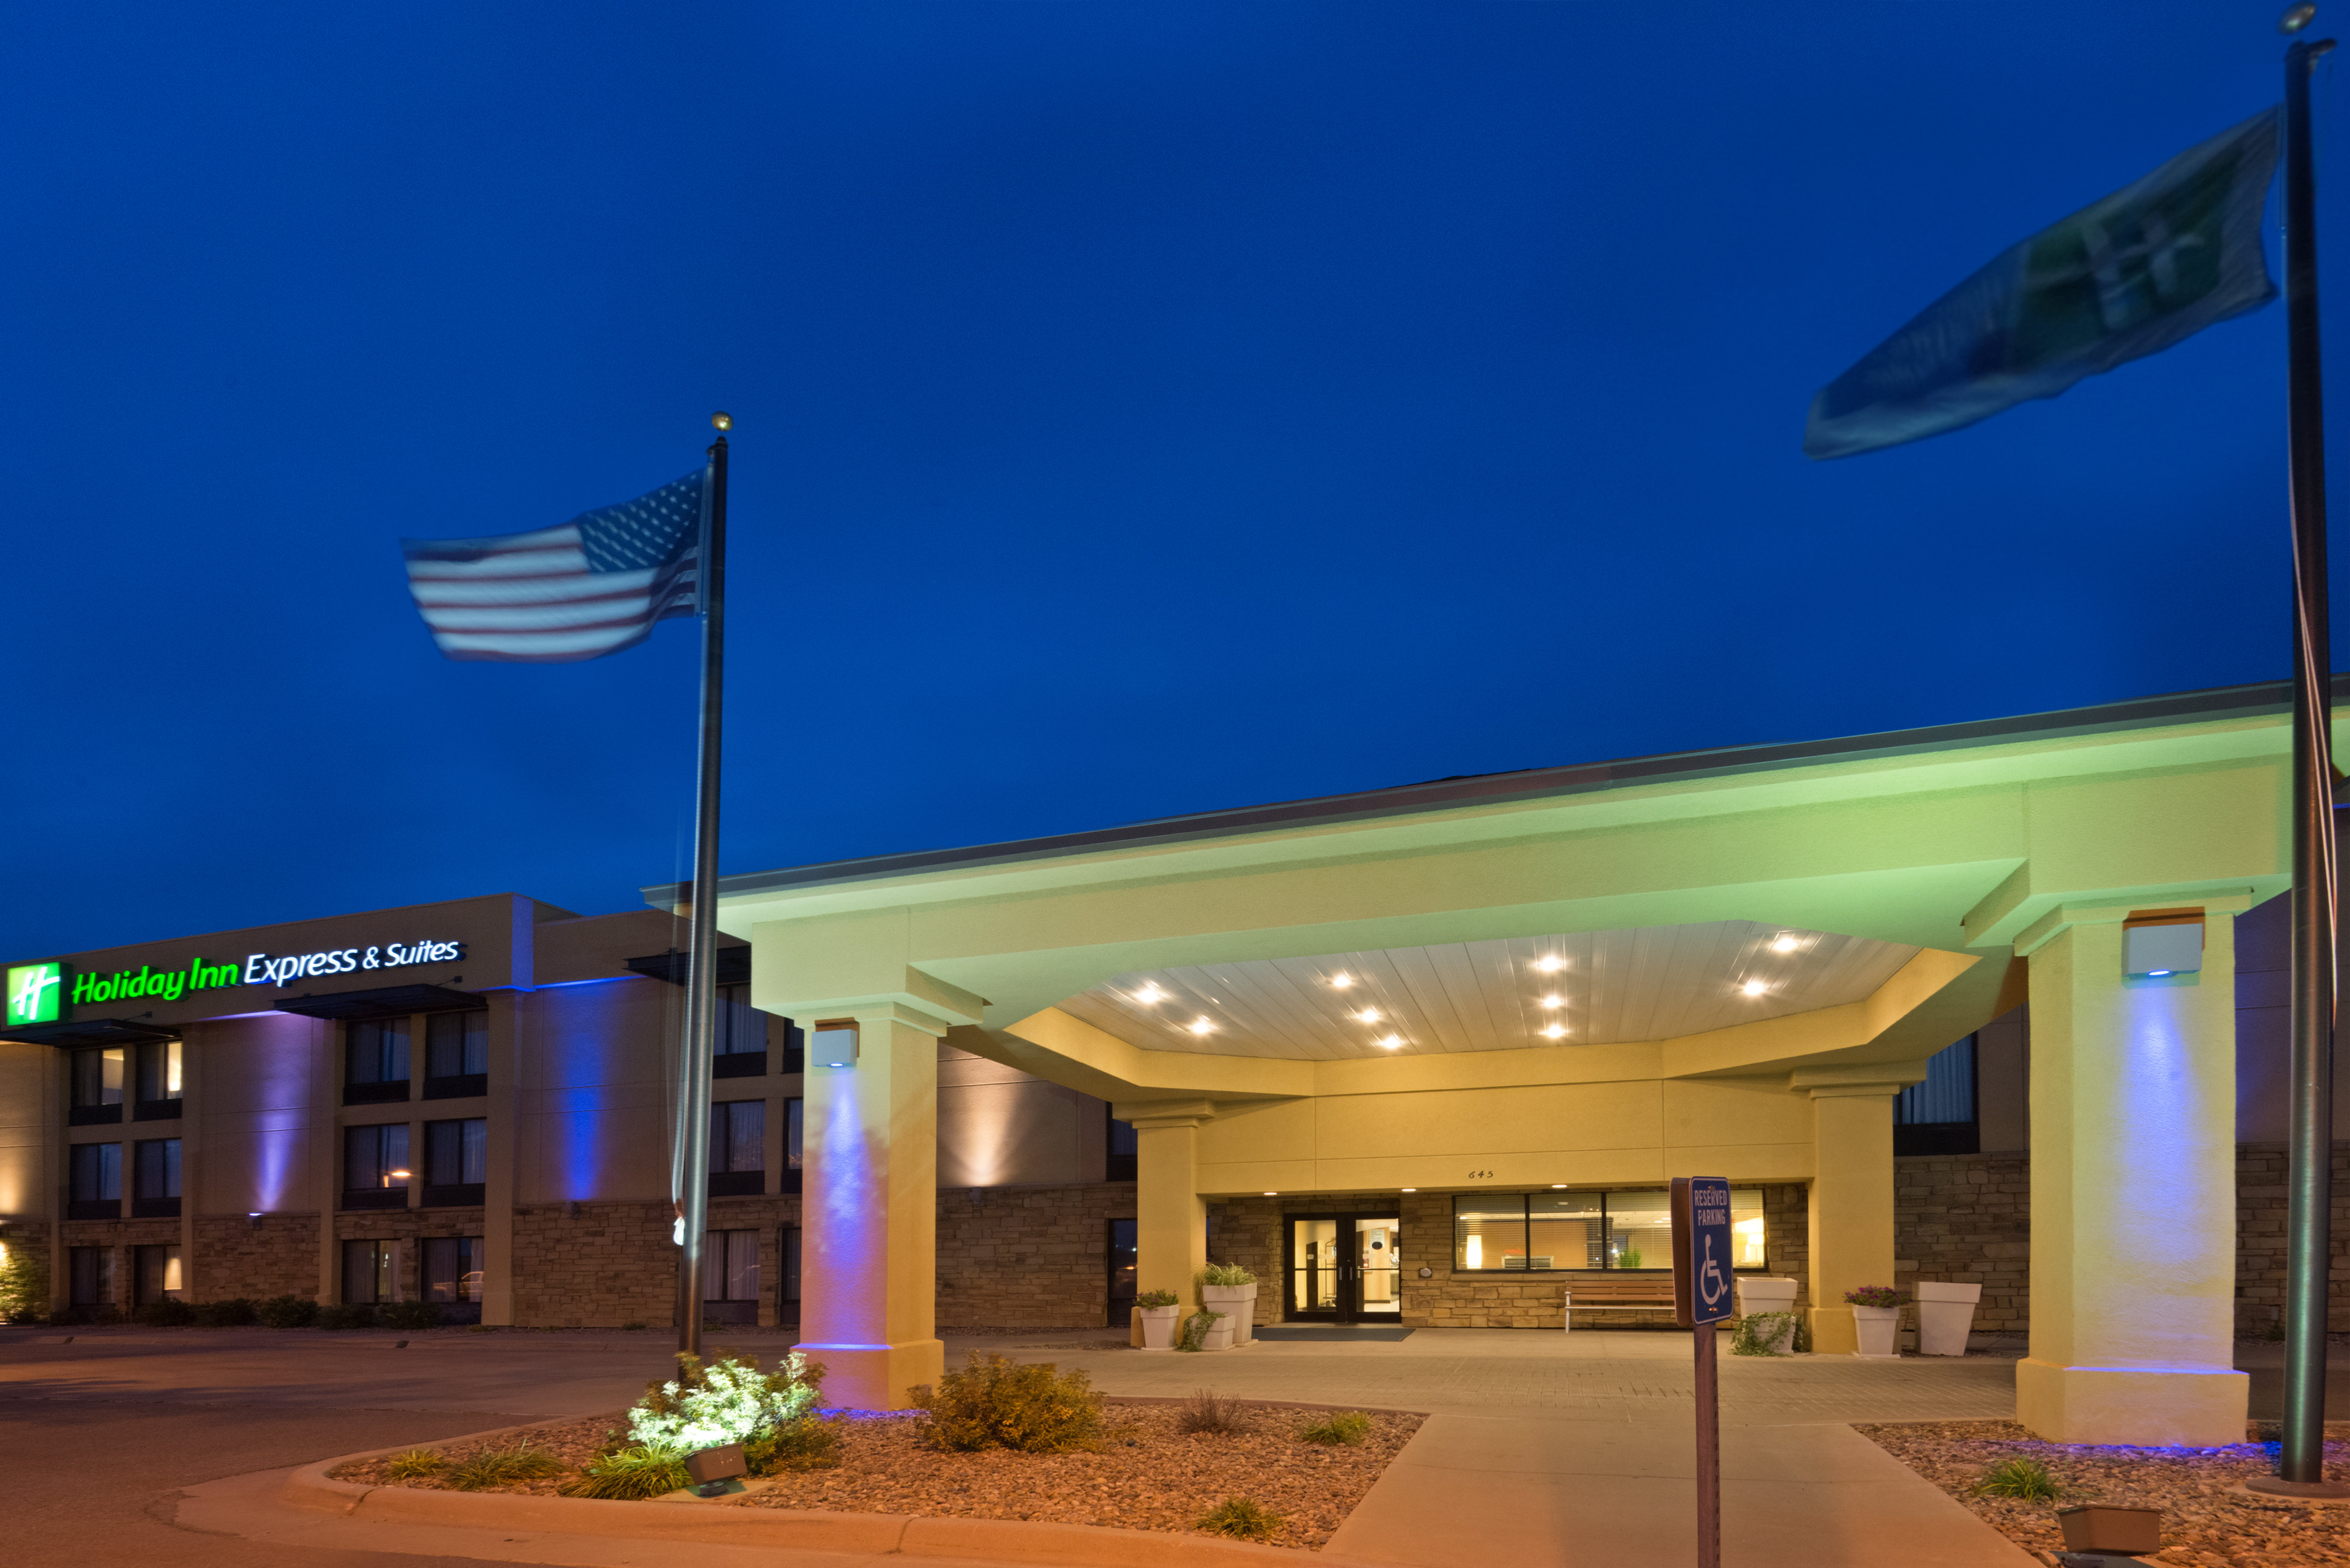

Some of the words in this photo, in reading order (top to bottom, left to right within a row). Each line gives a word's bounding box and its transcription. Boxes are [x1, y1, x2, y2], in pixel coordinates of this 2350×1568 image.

[71, 965, 186, 1004] Holiday
[189, 957, 238, 989] Inn
[243, 949, 358, 987] Express
[362, 946, 379, 969] &
[385, 940, 458, 966] Suites
[1694, 1190, 1727, 1206] RESERVED
[1698, 1209, 1725, 1226] PARKING
